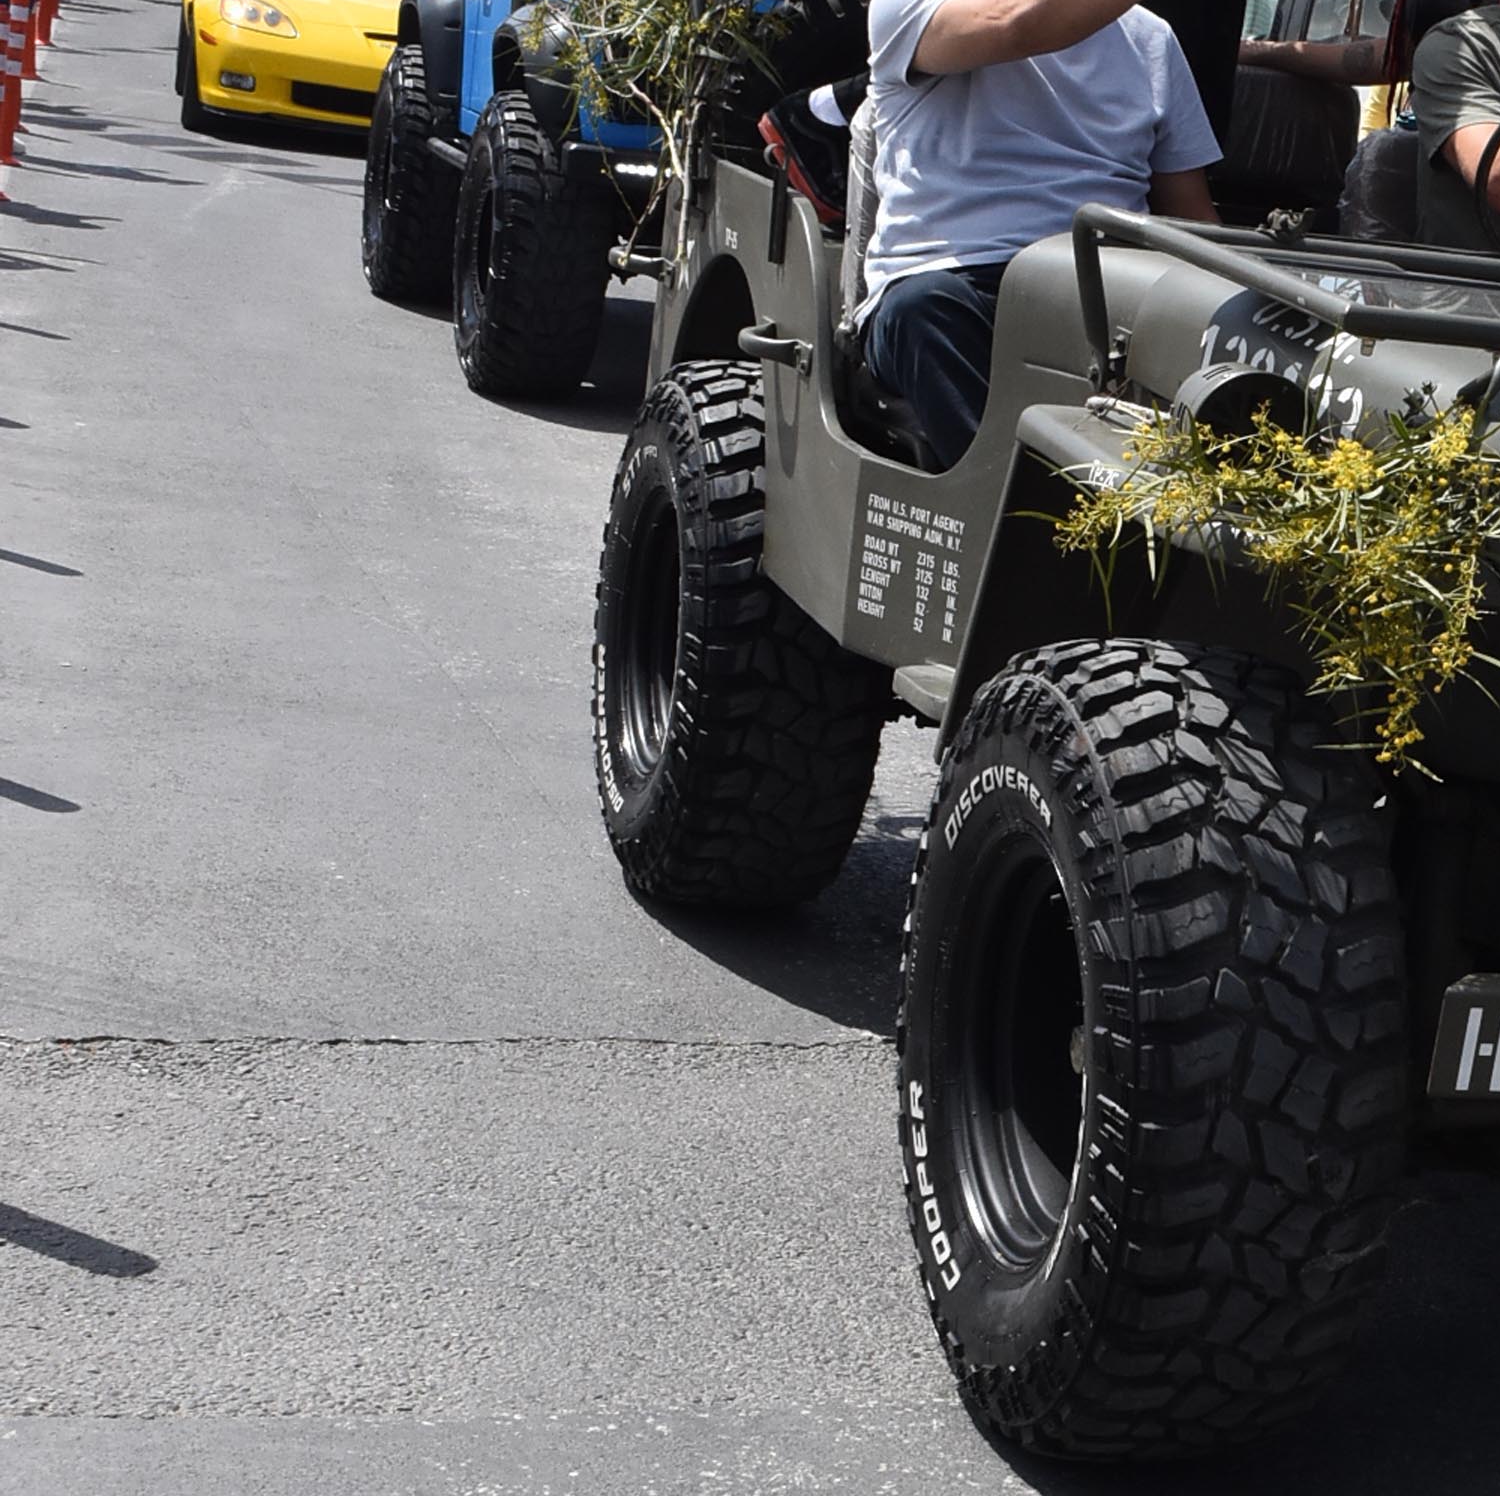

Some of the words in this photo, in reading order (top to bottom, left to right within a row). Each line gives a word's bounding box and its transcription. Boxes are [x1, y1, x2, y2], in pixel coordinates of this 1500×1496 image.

[867, 510, 884, 527] WAR
[886, 516, 922, 539] SHIPPING
[868, 493, 890, 512] FROM
[892, 501, 908, 517] U.S.
[910, 506, 931, 525] PORT
[933, 513, 965, 535] AGENCY
[862, 551, 887, 570] GROSS
[890, 560, 902, 575] WT
[915, 568, 933, 585] 3125
[941, 576, 959, 595] LBS.
[864, 534, 886, 553] ROAD
[888, 541, 899, 557] WT
[916, 551, 935, 569] 2315
[943, 560, 960, 578] LBS.
[916, 584, 930, 601] 132
[857, 598, 885, 619] HEIGHT
[913, 617, 924, 633] 52
[944, 764, 1052, 851] DISCOVERER
[909, 1080, 961, 1292] COOPER
